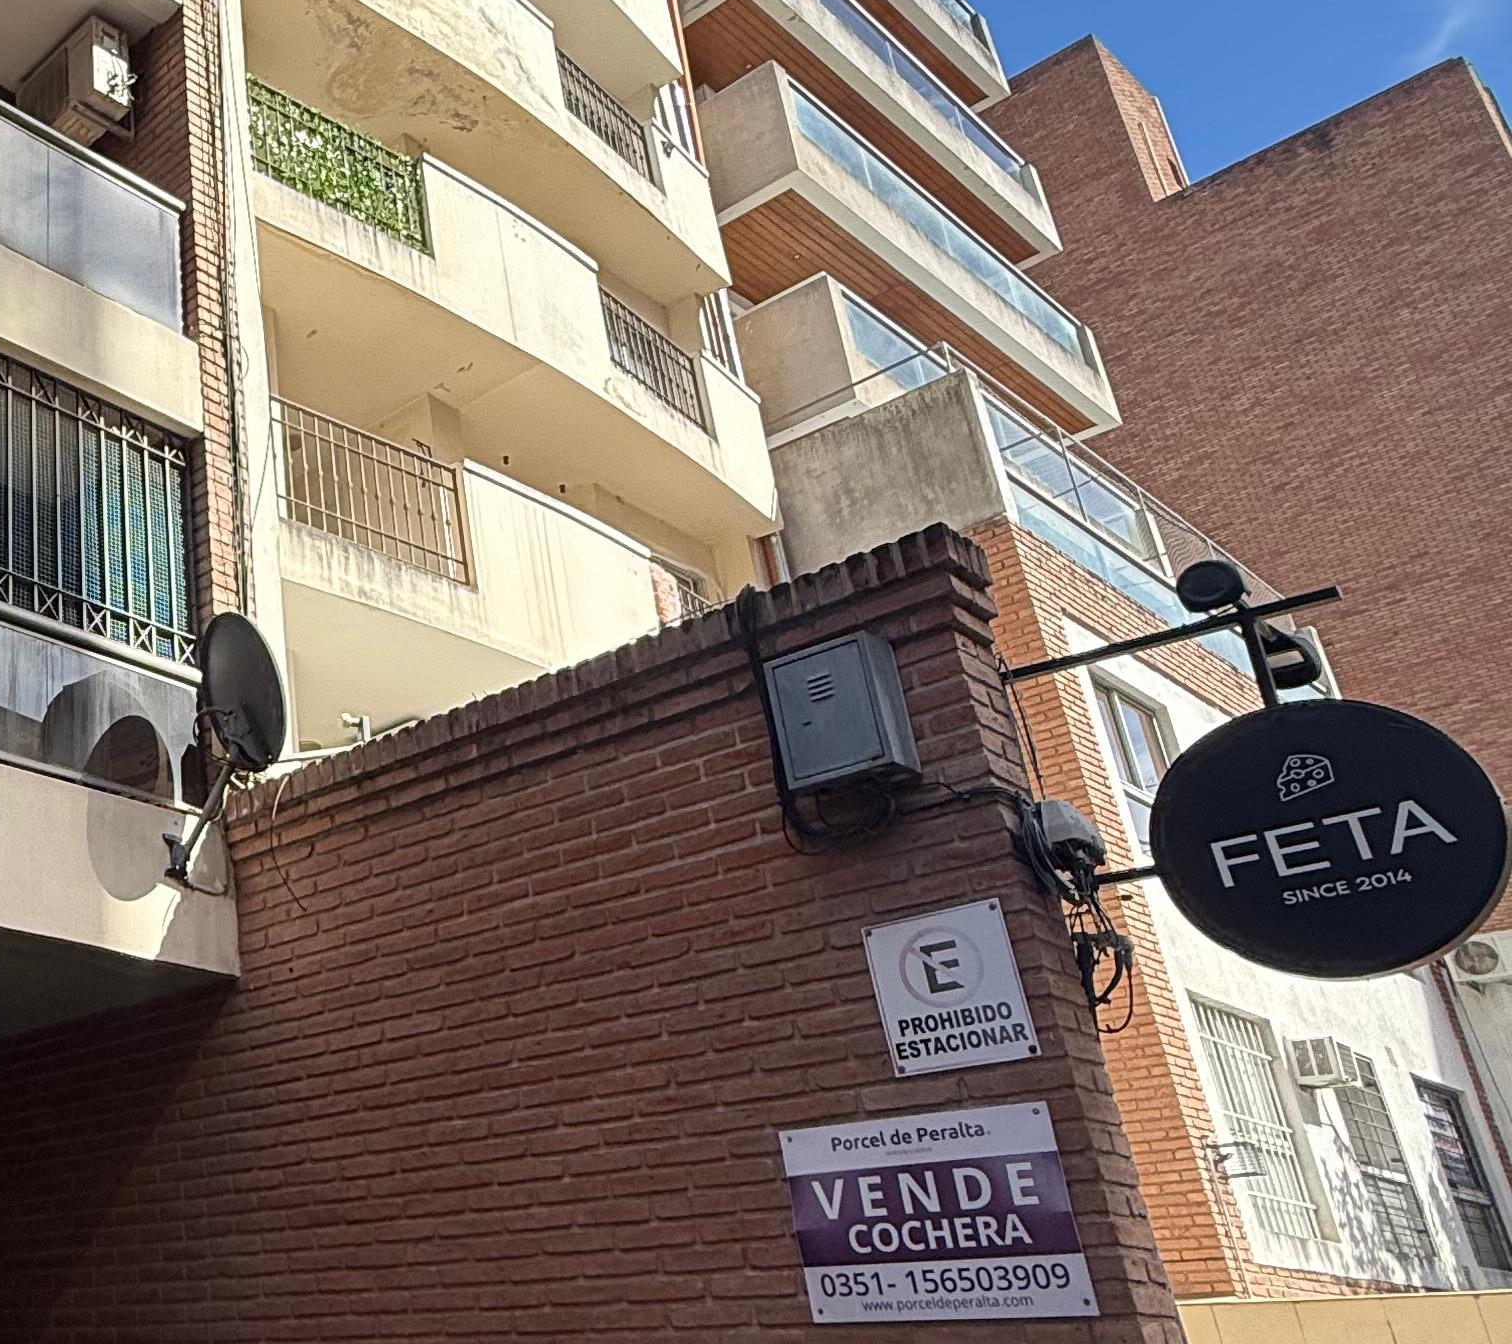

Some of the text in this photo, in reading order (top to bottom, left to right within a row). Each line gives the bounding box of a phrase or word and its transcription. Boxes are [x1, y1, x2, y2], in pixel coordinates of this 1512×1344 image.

[1210, 799, 1458, 888] FETA
[1282, 868, 1412, 905] SINCE 2014
[898, 1001, 1013, 1037] PROHIBIDO
[895, 1022, 1030, 1060] ESTACIONAR
[830, 1131, 887, 1153] Porcel
[890, 1128, 913, 1146] de
[916, 1121, 986, 1143] Peralta
[811, 1161, 1040, 1221] VENDE
[848, 1213, 1033, 1255] COCHERA
[905, 1262, 1070, 1295] 156503909
[861, 1294, 1035, 1313] www.porceldeperalta.com
